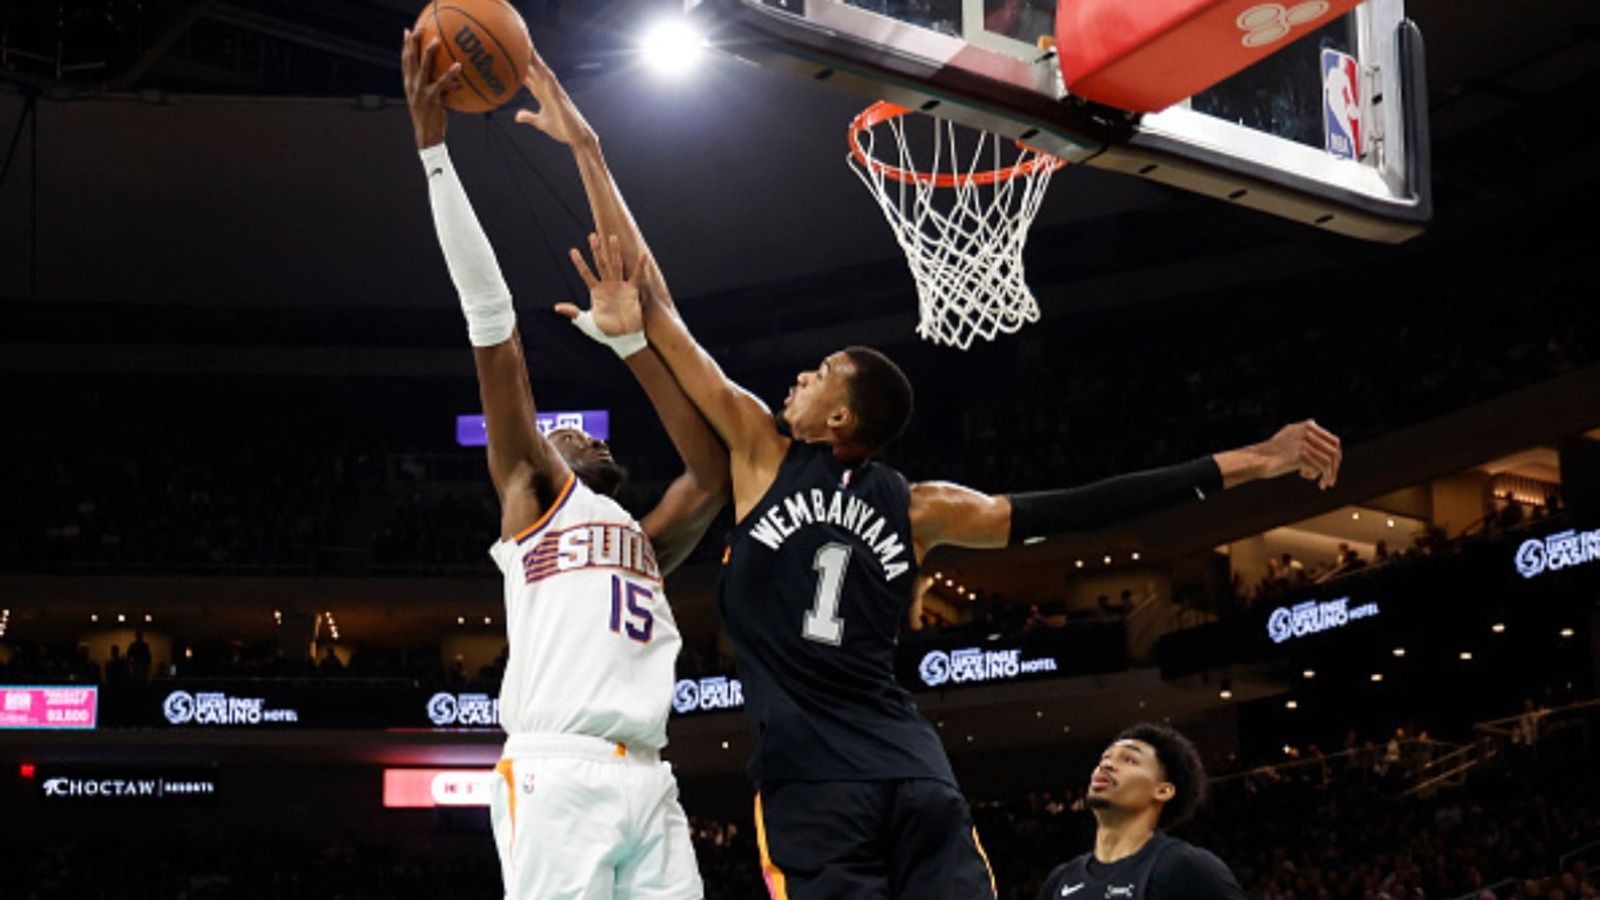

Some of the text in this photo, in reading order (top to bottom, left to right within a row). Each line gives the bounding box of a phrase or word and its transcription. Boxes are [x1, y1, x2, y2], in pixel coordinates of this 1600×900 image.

[455, 25, 507, 97] Wilson
[750, 488, 909, 581] WEMBANYAMA
[610, 573, 653, 643] 15
[803, 541, 852, 646] 1
[950, 658, 1057, 683] CASINO HOTEL
[196, 707, 261, 724] CASINO
[43, 777, 155, 797] CHOCTAW
